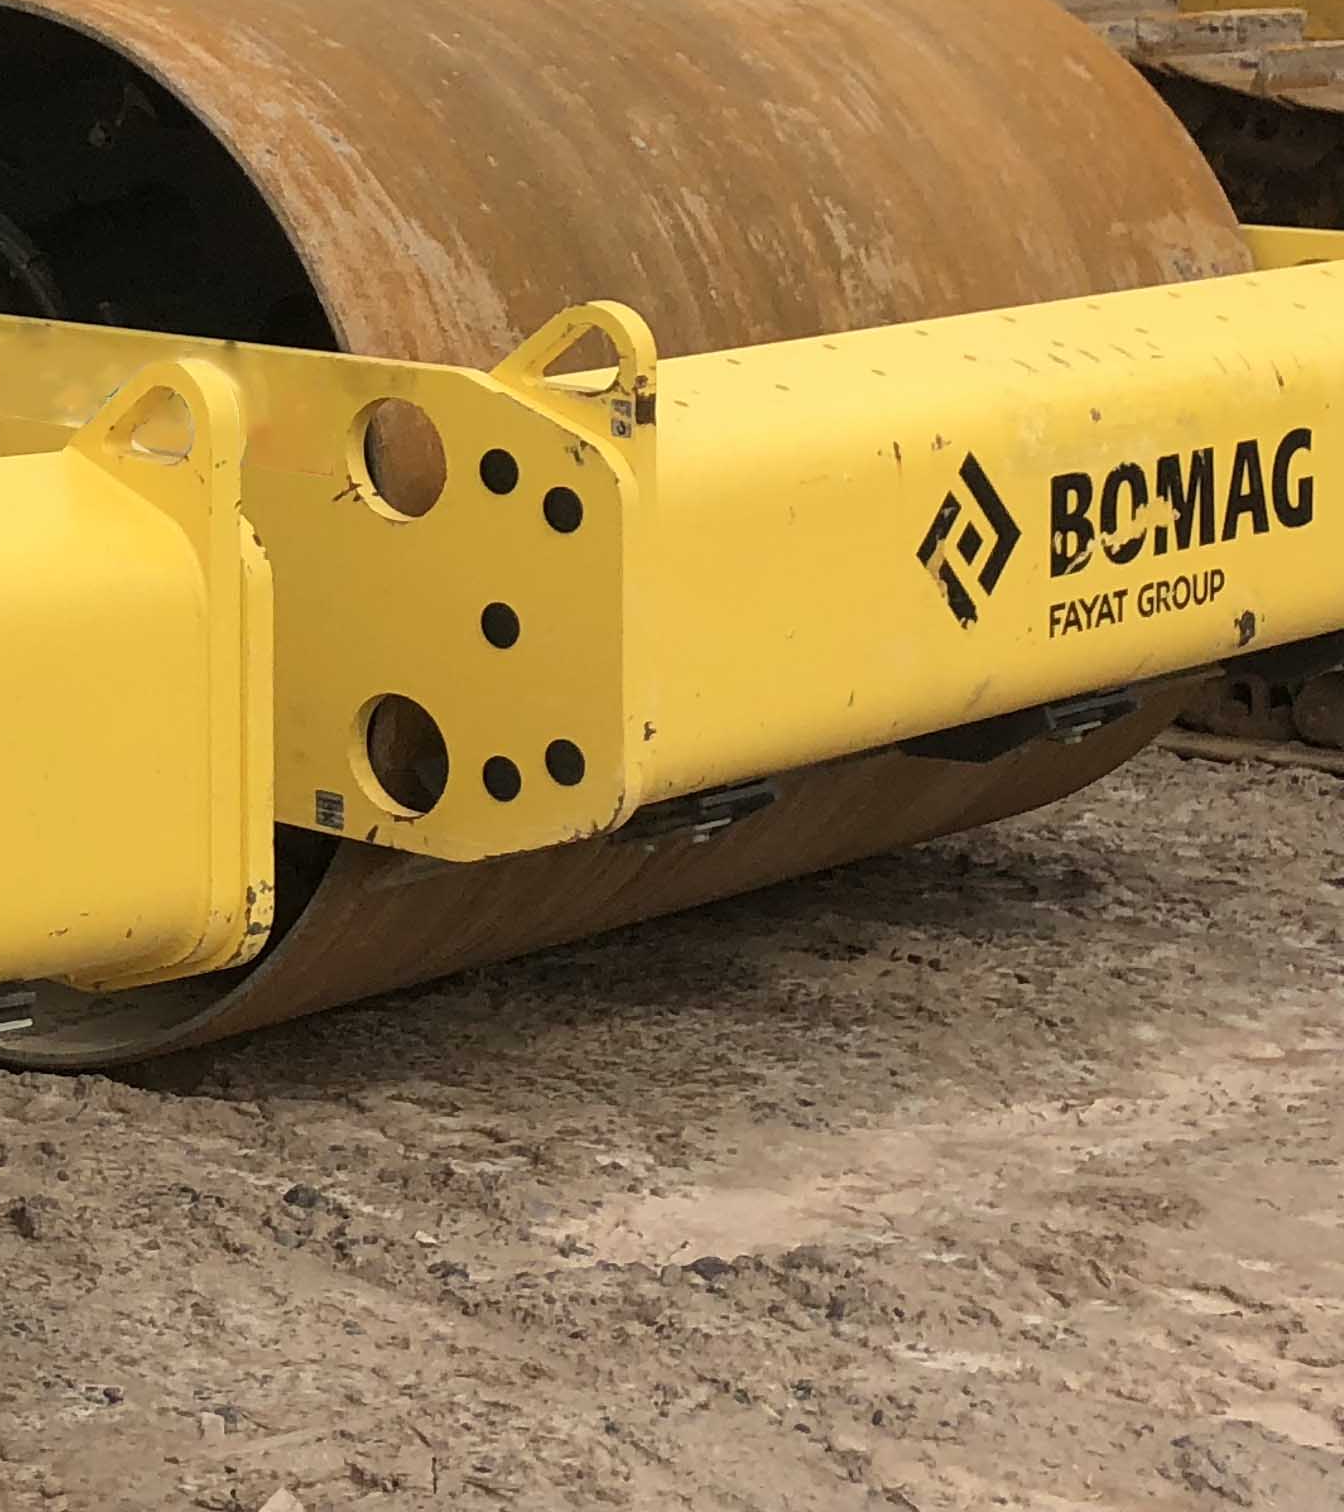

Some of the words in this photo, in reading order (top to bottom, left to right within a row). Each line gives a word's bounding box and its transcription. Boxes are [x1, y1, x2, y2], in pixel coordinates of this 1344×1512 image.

[1050, 427, 1314, 579] BOMAG
[1049, 589, 1129, 639] FAYAT
[1136, 569, 1226, 619] GROUP
